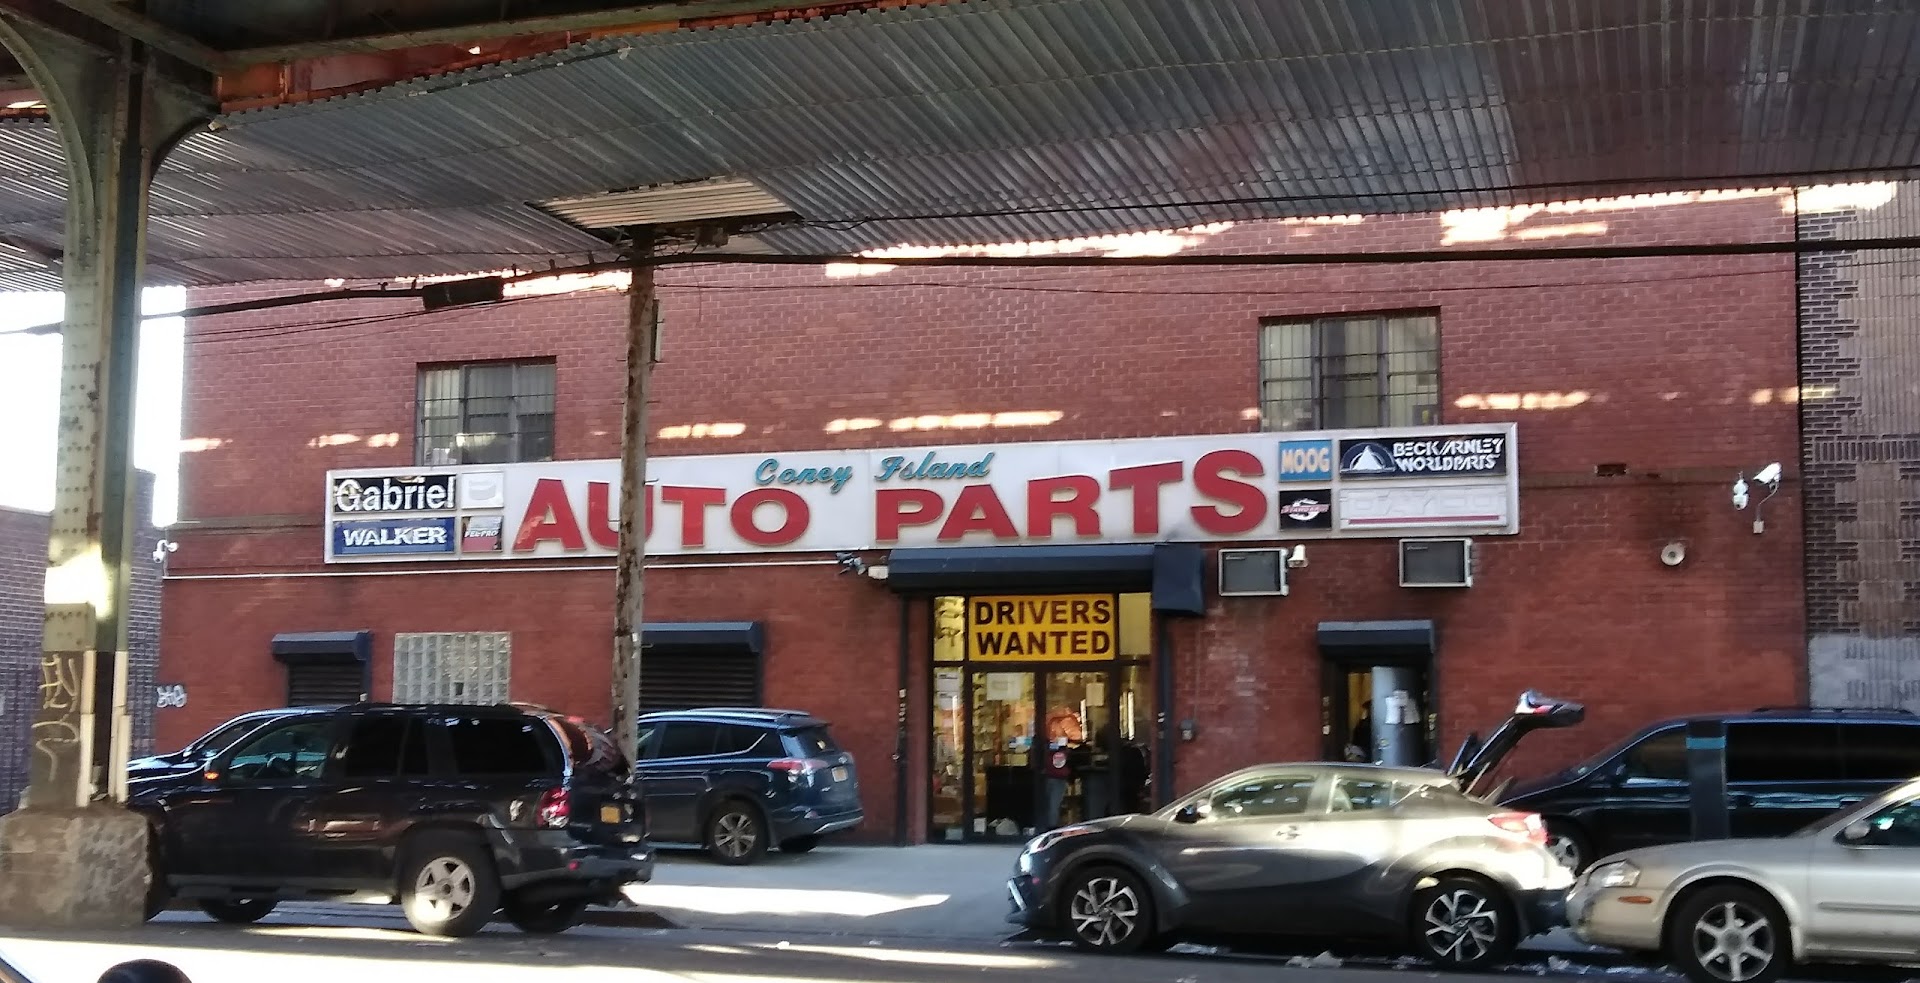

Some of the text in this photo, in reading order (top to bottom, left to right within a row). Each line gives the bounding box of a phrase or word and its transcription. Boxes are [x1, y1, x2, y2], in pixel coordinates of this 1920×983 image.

[755, 450, 995, 494] Coney Island
[1281, 447, 1330, 473] MOOG
[1395, 453, 1500, 472] WORLDPARTS
[335, 475, 454, 511] Gabriel
[512, 449, 1268, 551] AUTO PARTS
[343, 527, 447, 546] WALKER
[975, 600, 1110, 625] DRIVERS
[976, 630, 1110, 655] WANTED
